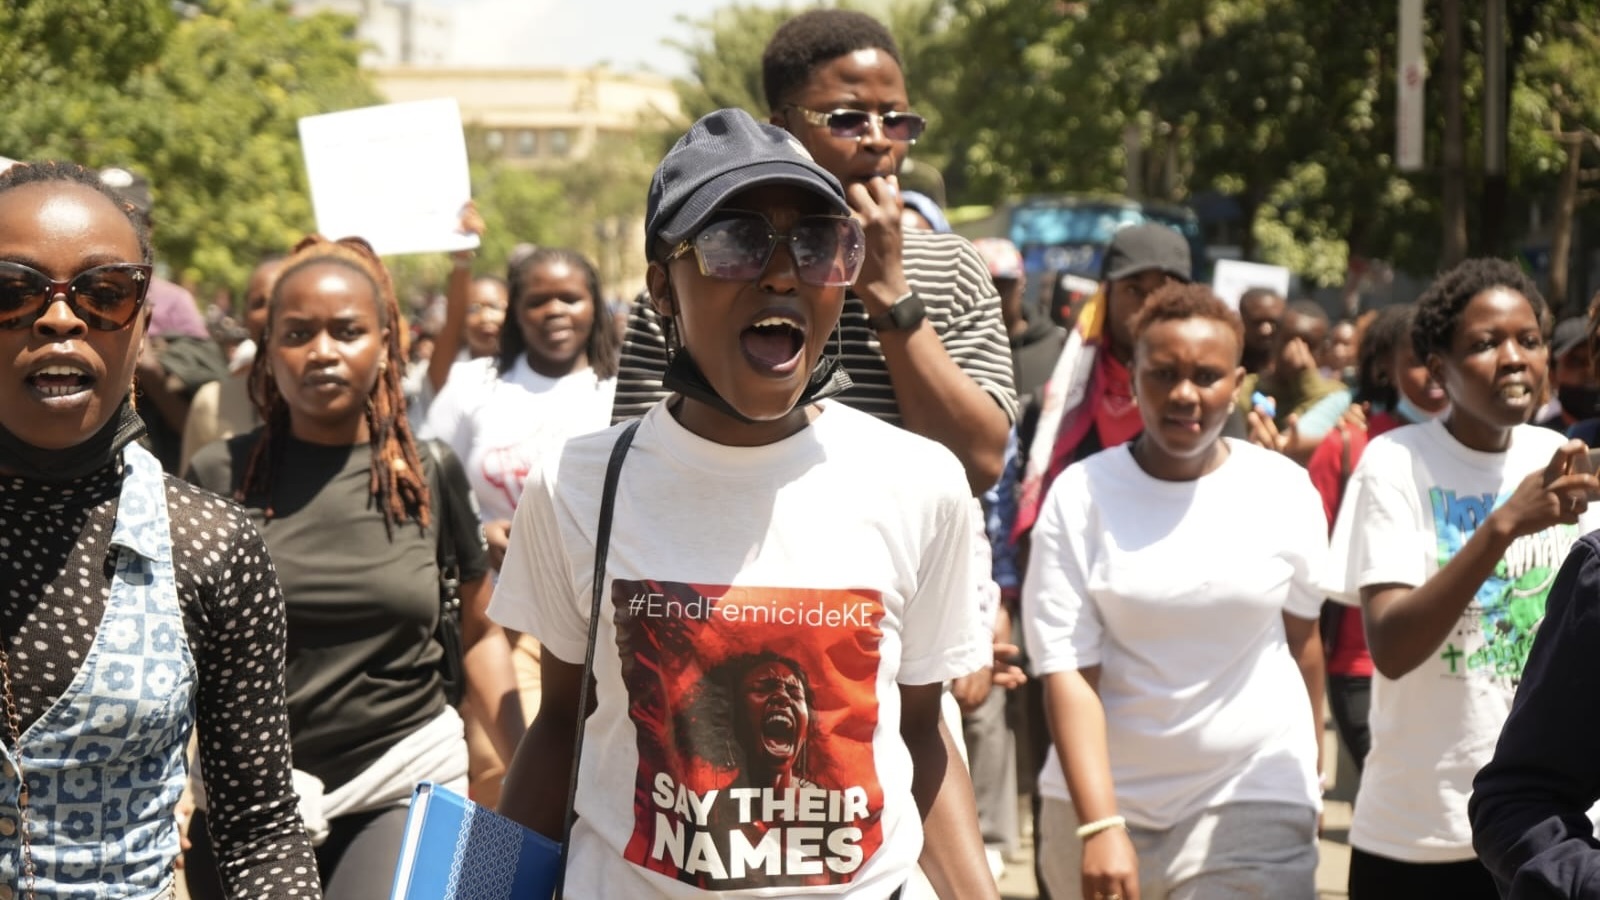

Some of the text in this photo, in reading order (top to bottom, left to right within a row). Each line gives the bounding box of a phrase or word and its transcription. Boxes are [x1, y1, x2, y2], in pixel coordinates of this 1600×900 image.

[628, 593, 873, 627] #EndFemicideKE
[652, 772, 869, 826] SAY THEIR
[652, 812, 864, 880] NAMES
